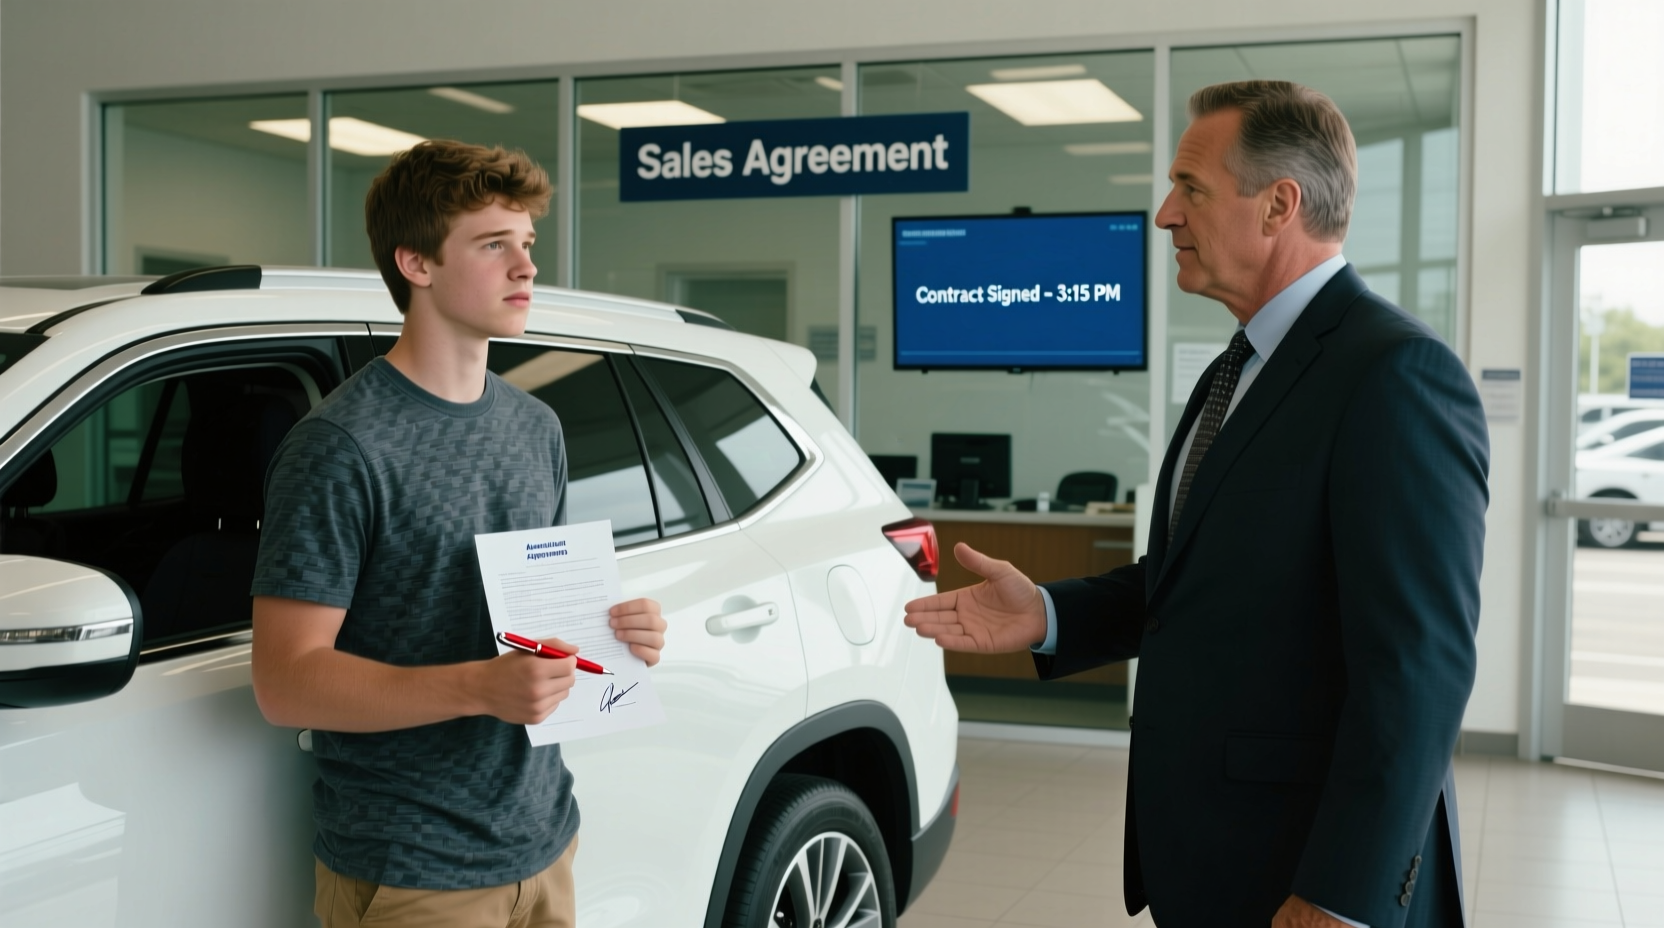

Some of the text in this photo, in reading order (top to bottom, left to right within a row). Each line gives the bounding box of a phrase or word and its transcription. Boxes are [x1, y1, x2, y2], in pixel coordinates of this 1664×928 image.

[638, 135, 948, 184] Sales Agreement
[916, 286, 984, 303] Contract
[988, 285, 1040, 306] Signed
[1057, 284, 1090, 302] 3:15
[1094, 284, 1120, 301] PM
